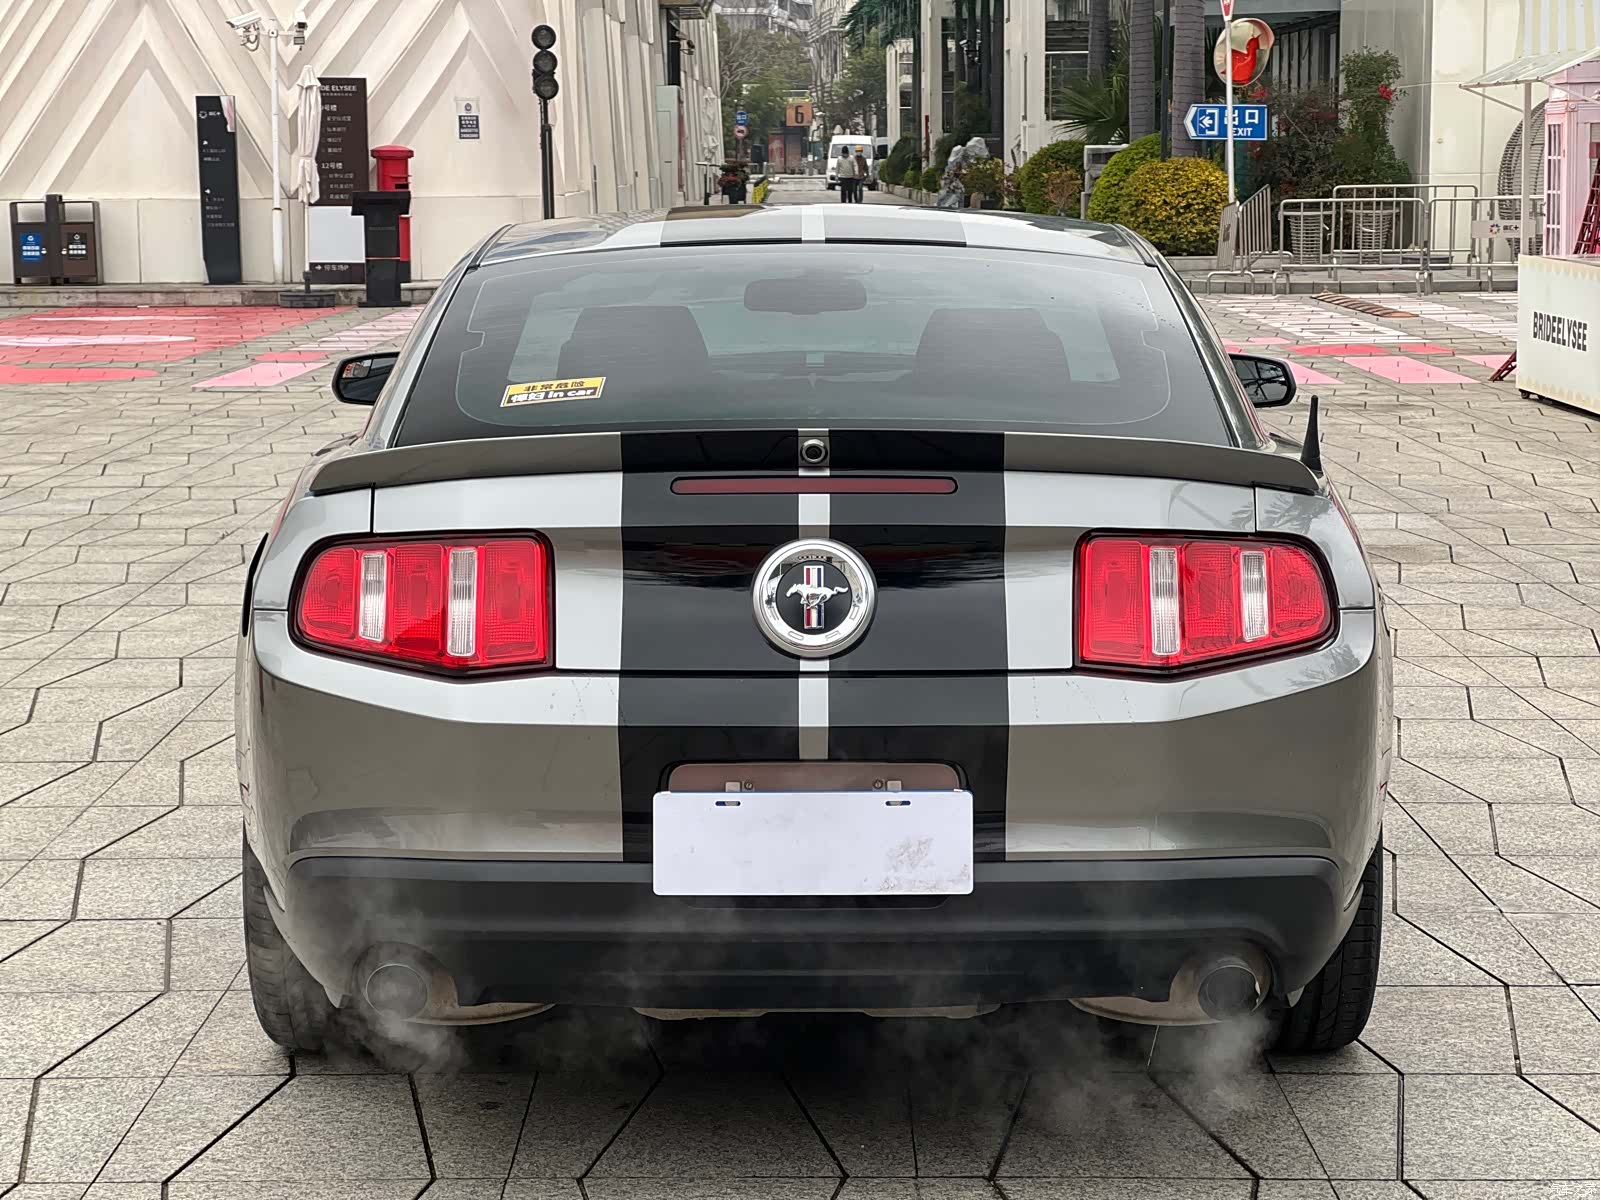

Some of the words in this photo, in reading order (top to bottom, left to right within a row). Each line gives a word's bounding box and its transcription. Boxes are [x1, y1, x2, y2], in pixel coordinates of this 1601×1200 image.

[795, 105, 805, 124] 6
[1232, 127, 1253, 137] EXIT
[1533, 311, 1588, 352] BRIDEELYSEE
[547, 390, 564, 399] in
[567, 388, 595, 398] car
